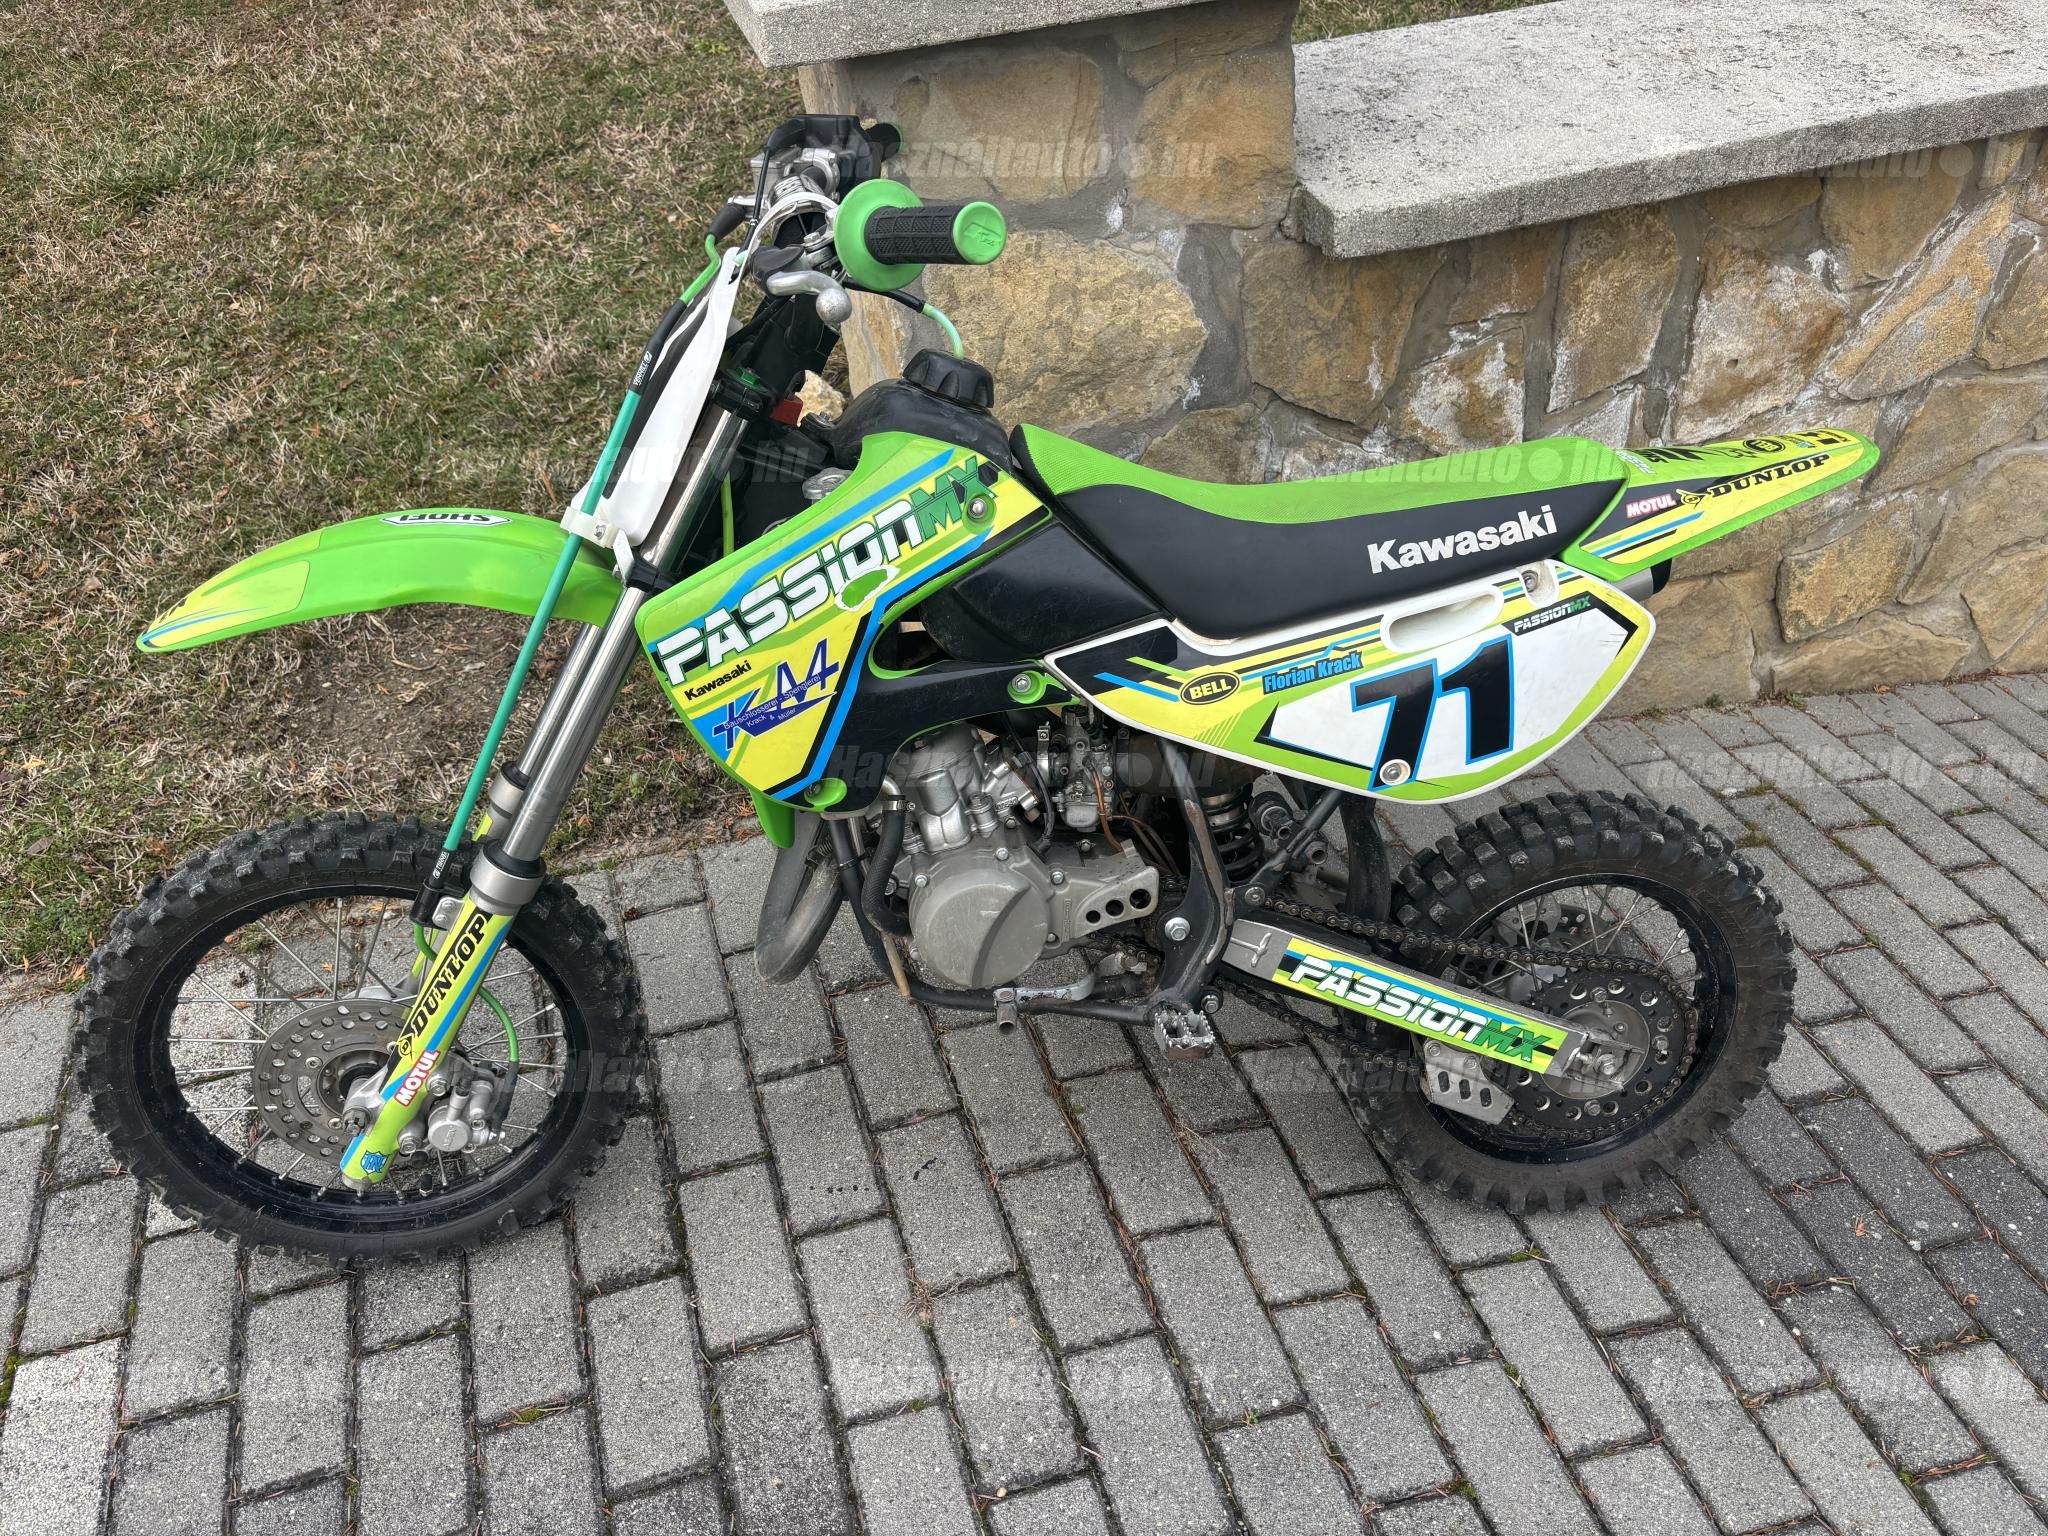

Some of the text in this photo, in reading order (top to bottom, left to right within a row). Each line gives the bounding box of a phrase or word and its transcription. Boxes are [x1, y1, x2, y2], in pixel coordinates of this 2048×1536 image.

[1711, 454, 1830, 498] DUNLOP
[1627, 494, 1677, 518] MOTUL
[1367, 504, 1558, 575] Kawasaki
[684, 660, 752, 700] Kawasaki
[1189, 678, 1232, 700] BELL
[1264, 651, 1362, 693] Florian Krack
[1350, 633, 1516, 792] 71
[411, 915, 487, 1036] DUNLOP
[396, 1051, 440, 1106] MOTUL
